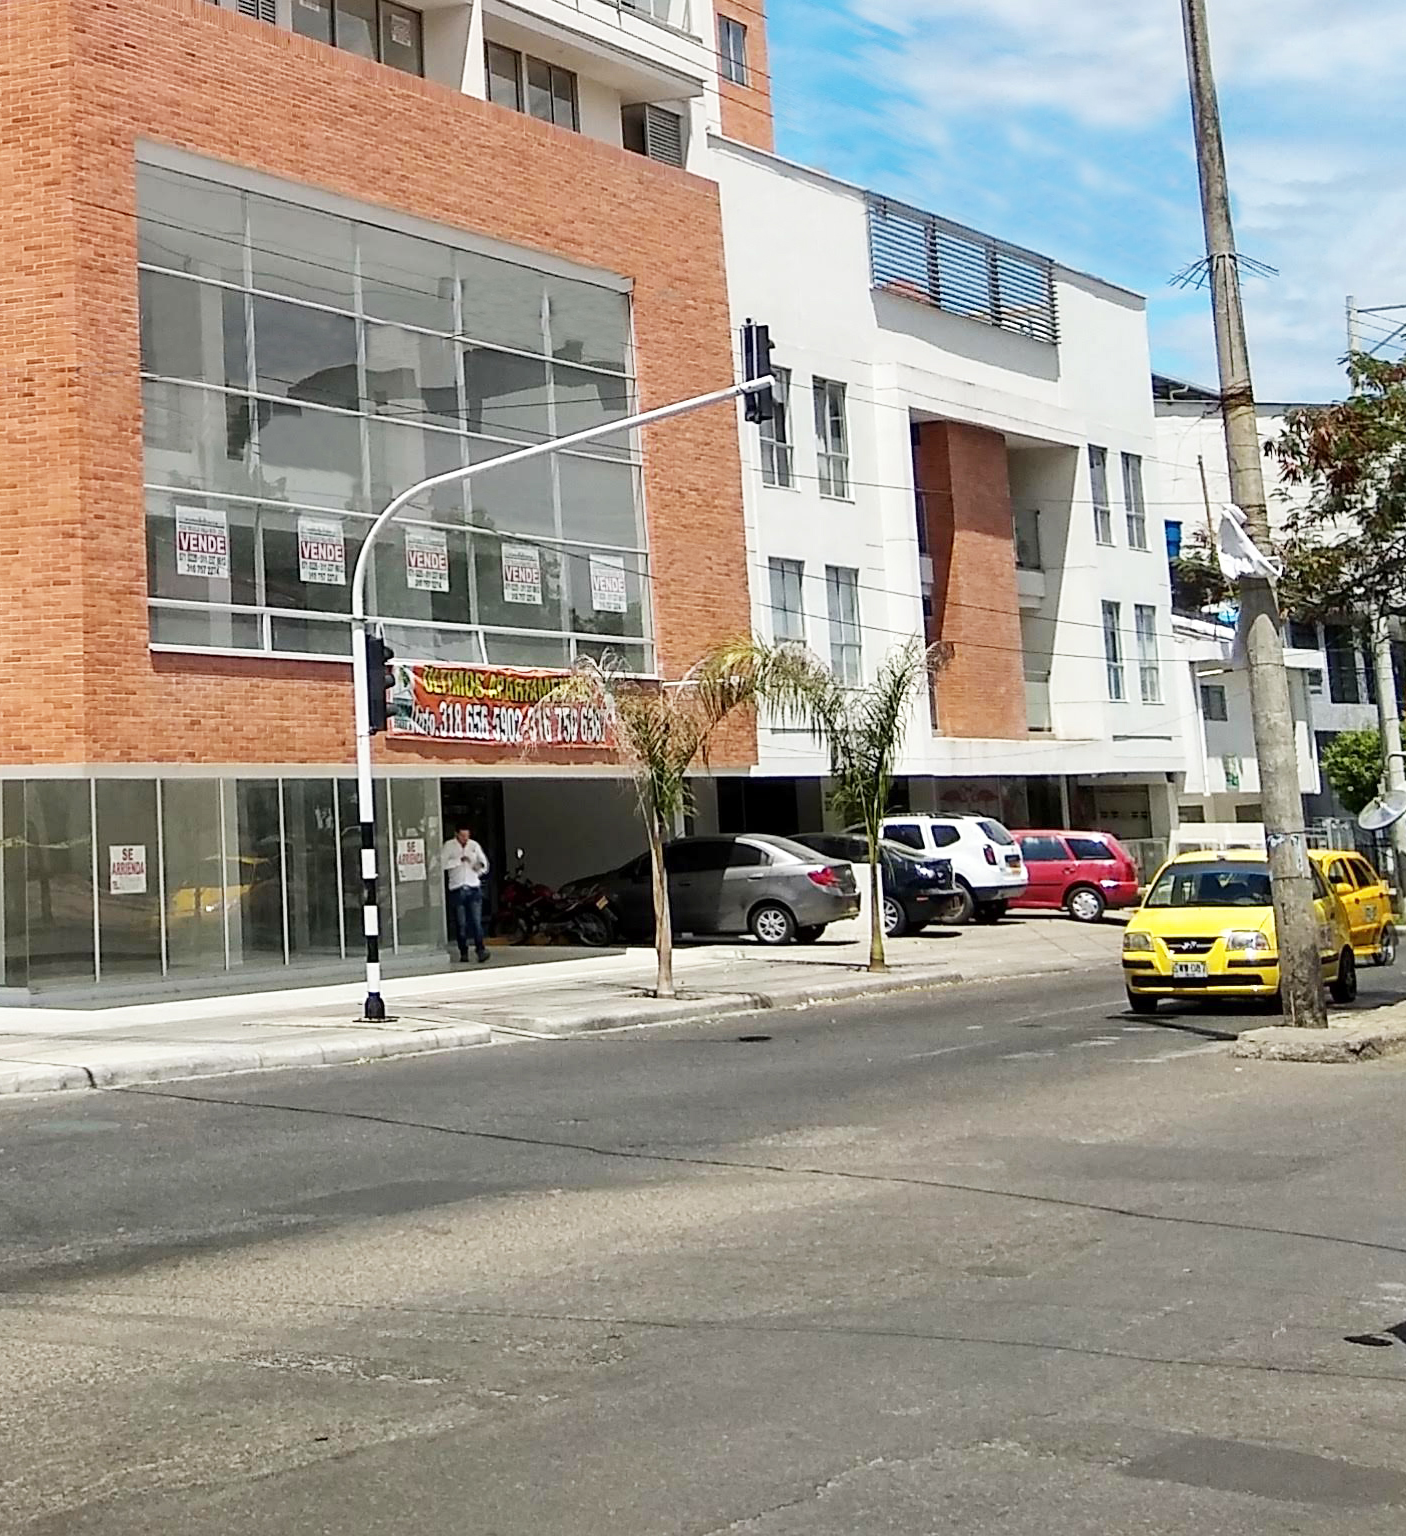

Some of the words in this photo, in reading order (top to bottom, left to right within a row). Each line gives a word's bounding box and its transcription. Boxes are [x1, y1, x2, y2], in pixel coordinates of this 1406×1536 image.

[179, 532, 225, 554] VENDE
[301, 541, 343, 561] VENDE
[408, 550, 446, 569] VENDE
[505, 566, 540, 583] VENDE
[594, 575, 625, 592] VENDE
[439, 700, 464, 739] 318
[465, 703, 491, 741] 656
[122, 848, 134, 861] SE
[407, 841, 416, 853] SE
[112, 861, 145, 875] ARRIENDA
